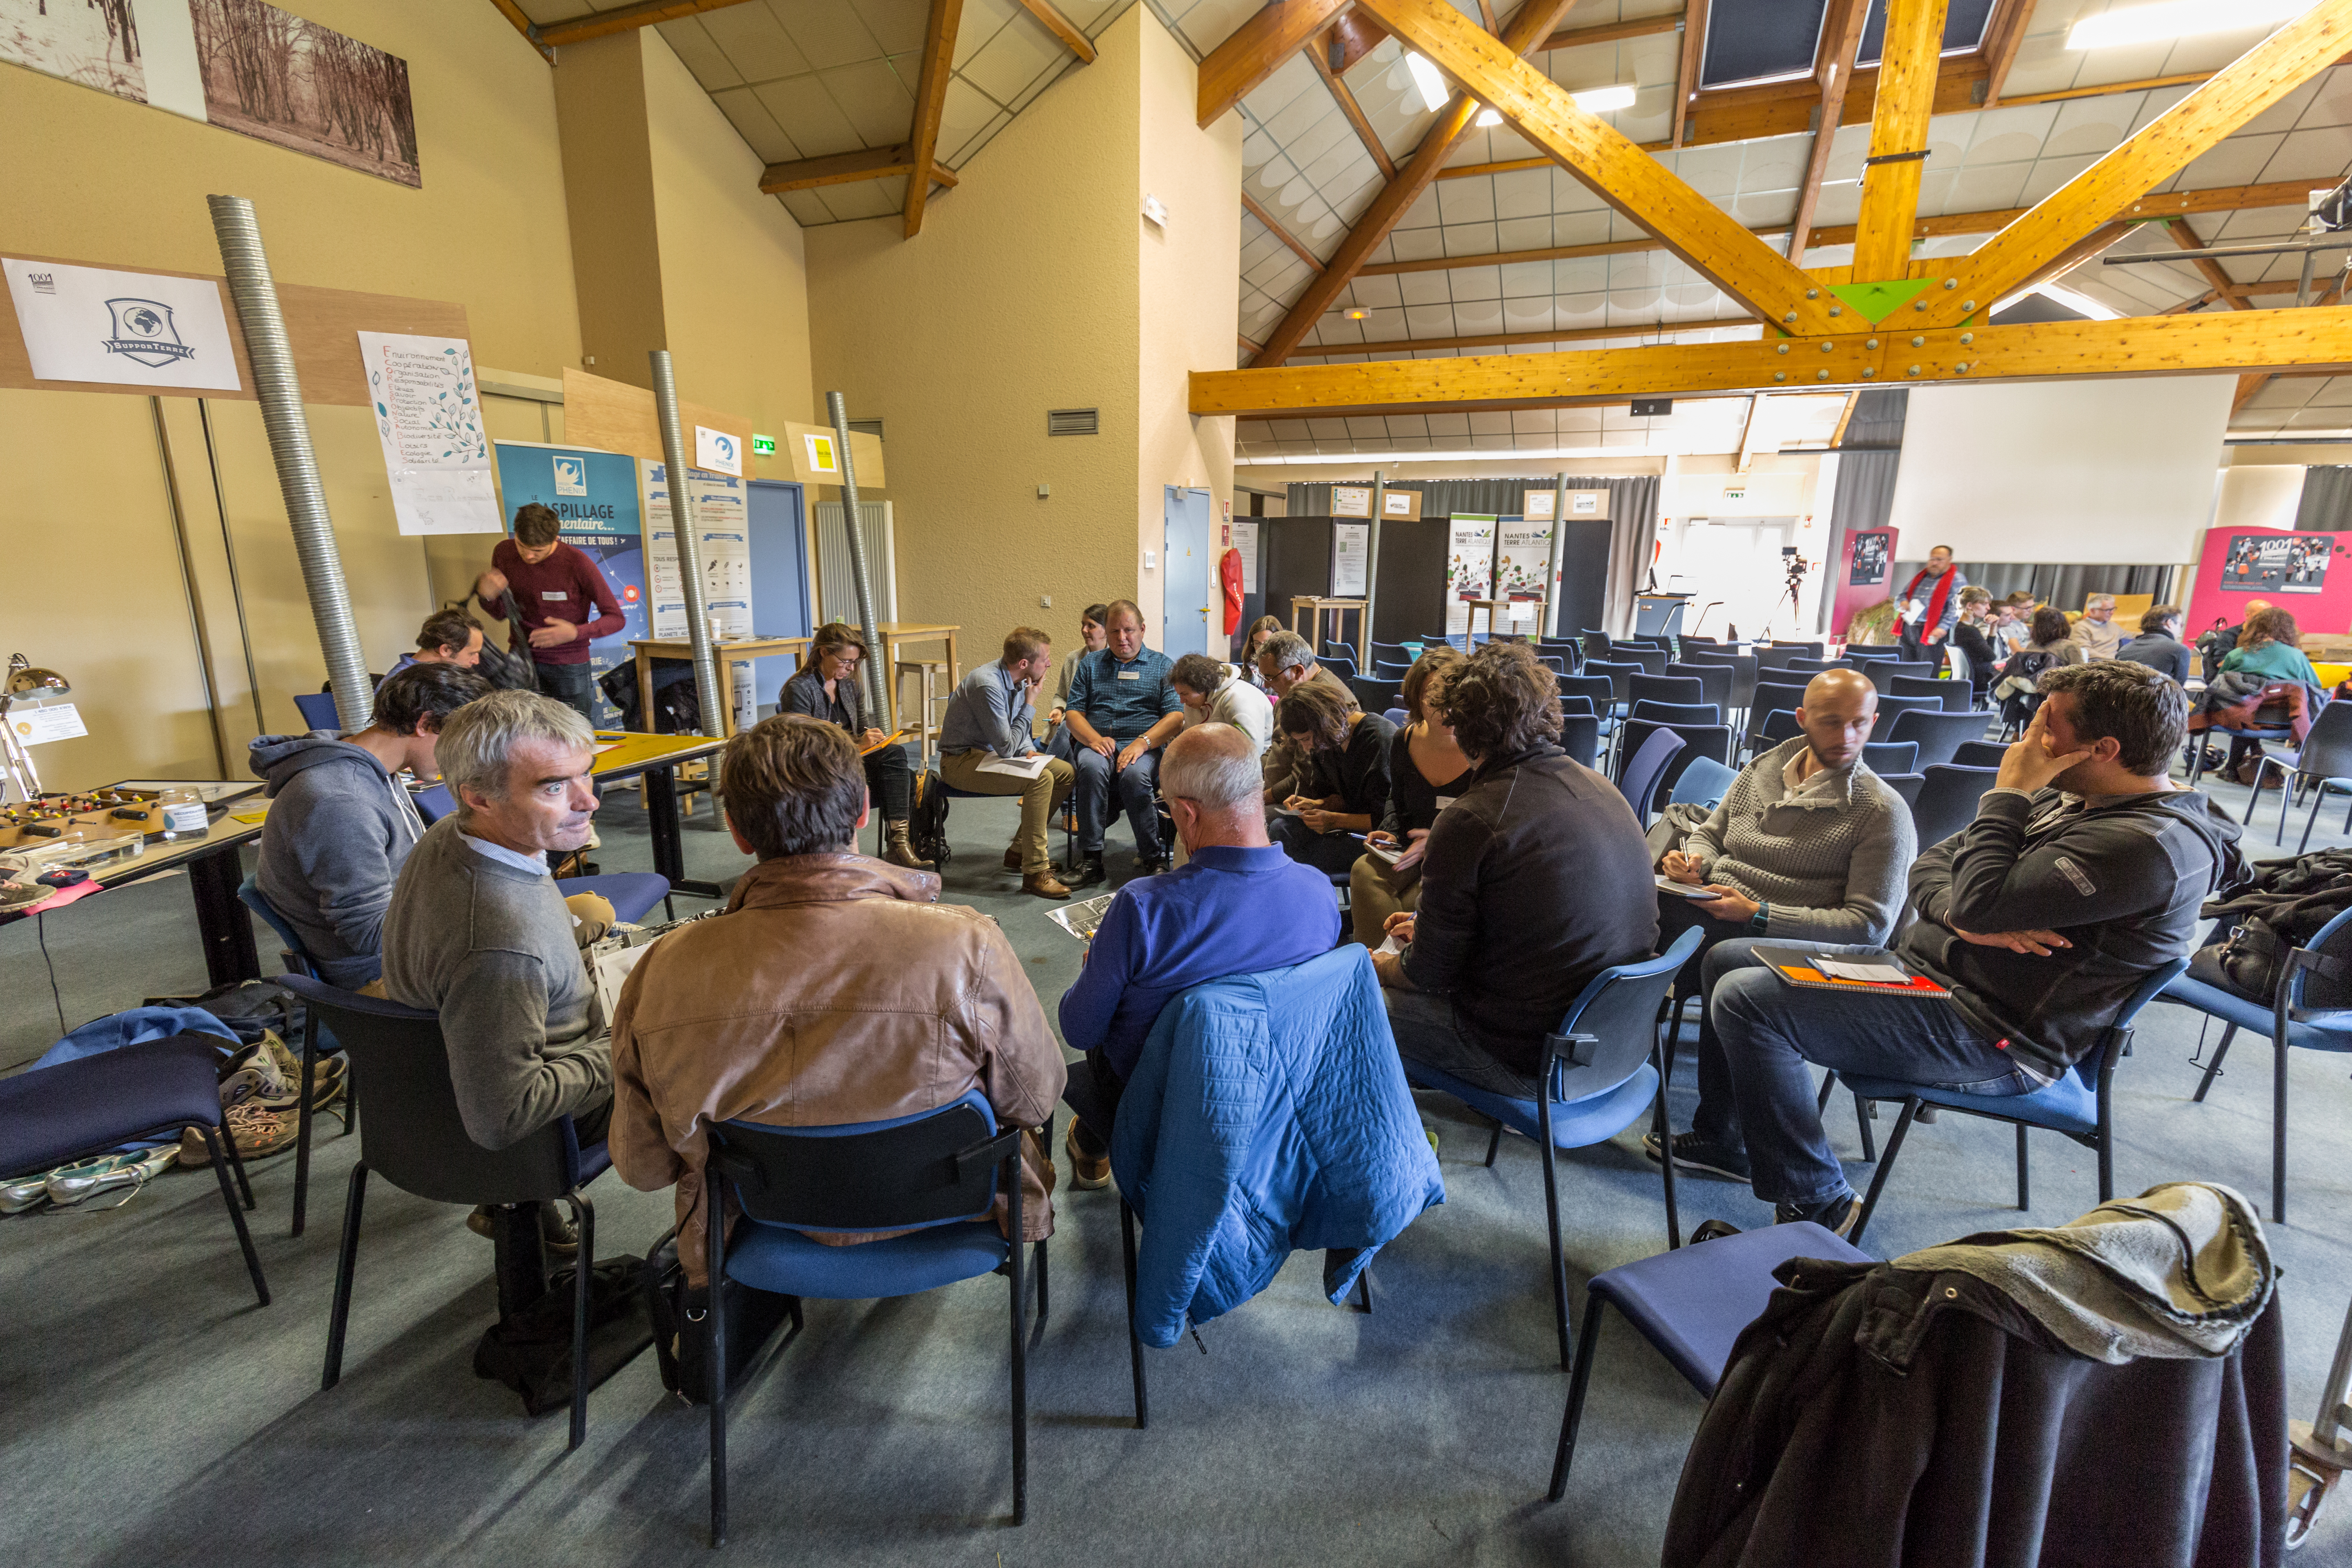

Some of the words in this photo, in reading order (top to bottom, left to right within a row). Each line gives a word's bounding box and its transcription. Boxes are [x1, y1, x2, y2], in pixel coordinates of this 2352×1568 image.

[386, 367, 440, 379] Organisation
[390, 396, 427, 405] Protection
[392, 410, 420, 418] Nature
[393, 416, 421, 424] Social
[715, 459, 734, 468] PHENIX
[557, 486, 585, 494] PHENIX
[588, 537, 596, 545] DE
[2259, 538, 2293, 560] 1001
